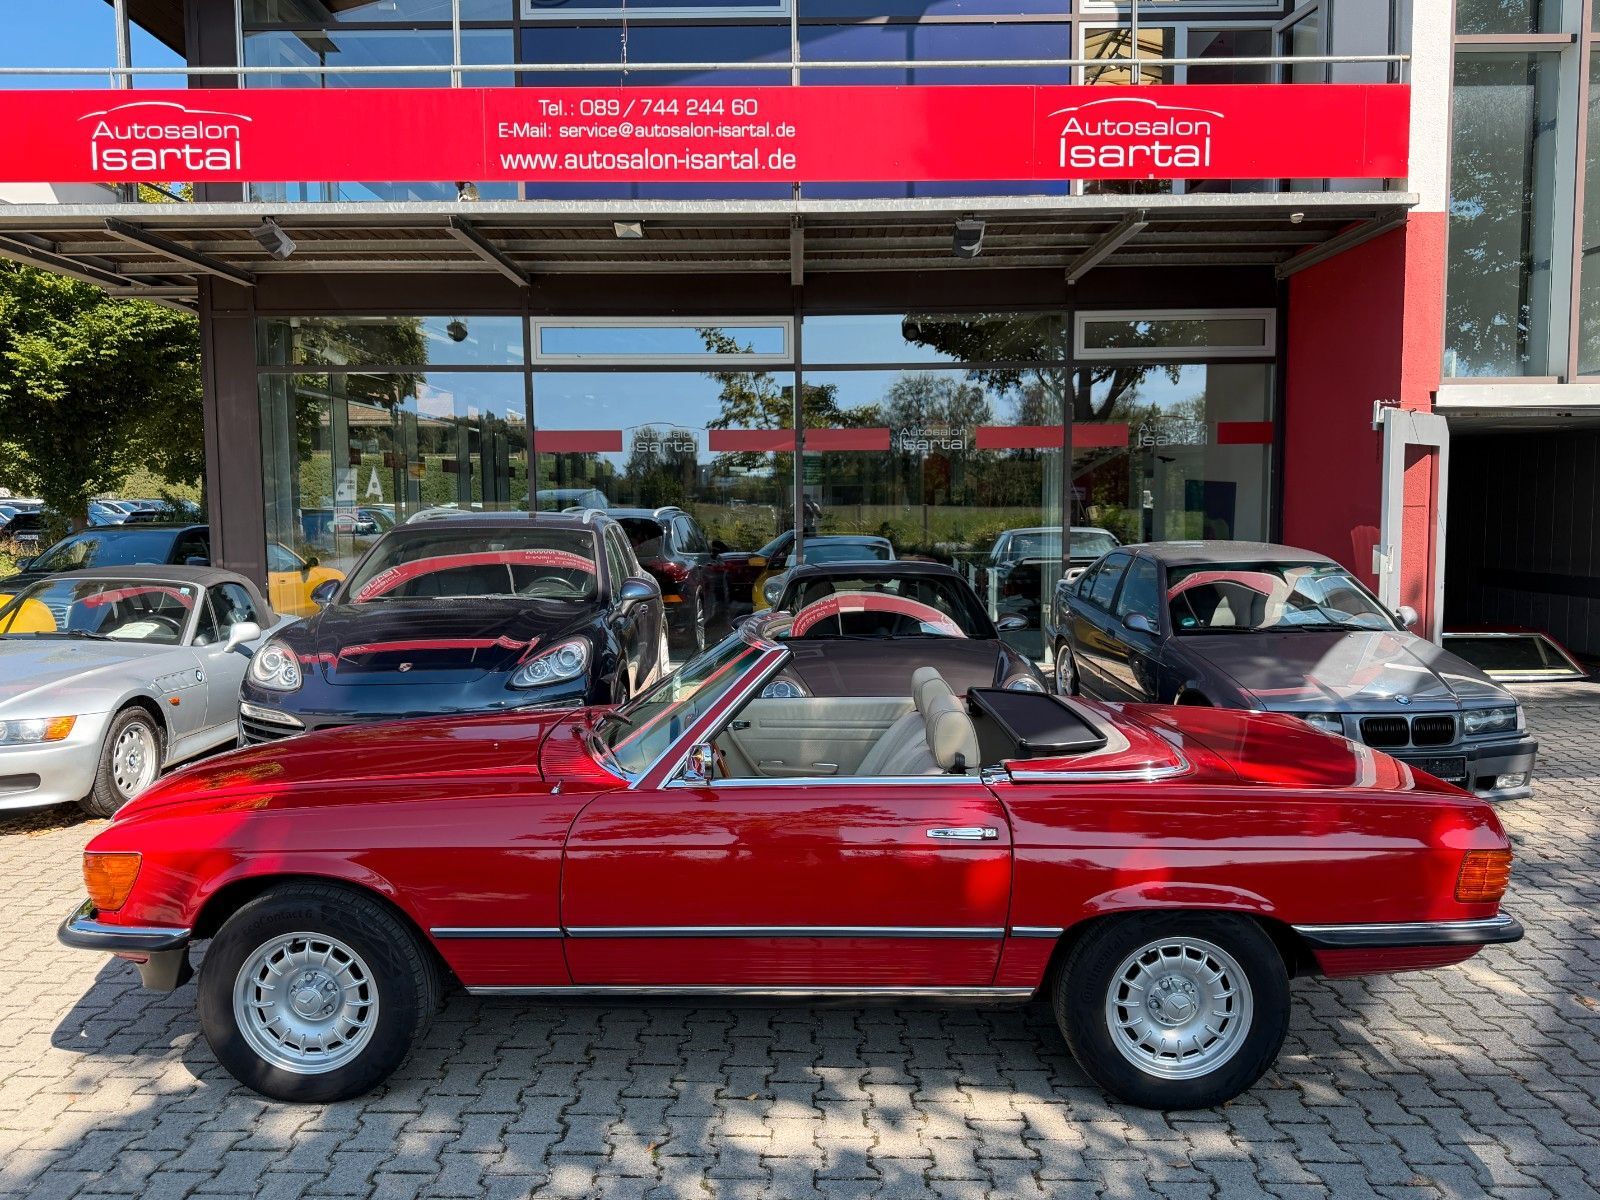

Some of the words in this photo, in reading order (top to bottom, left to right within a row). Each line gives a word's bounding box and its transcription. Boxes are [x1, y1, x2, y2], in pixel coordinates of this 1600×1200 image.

[640, 98, 679, 116] 744
[685, 98, 725, 116] 244
[731, 98, 758, 116] 60
[91, 120, 240, 139] Autosalon
[497, 122, 552, 138] E-Mail:
[558, 121, 796, 138] service@autosalon-isartal.de
[1060, 116, 1211, 136] Autosalon
[91, 140, 241, 171] Isartal
[499, 147, 797, 170] www.autosalon-isartal.de
[1059, 136, 1211, 168] Isartal
[900, 427, 968, 436] Autosalon
[899, 436, 968, 450] Isartal
